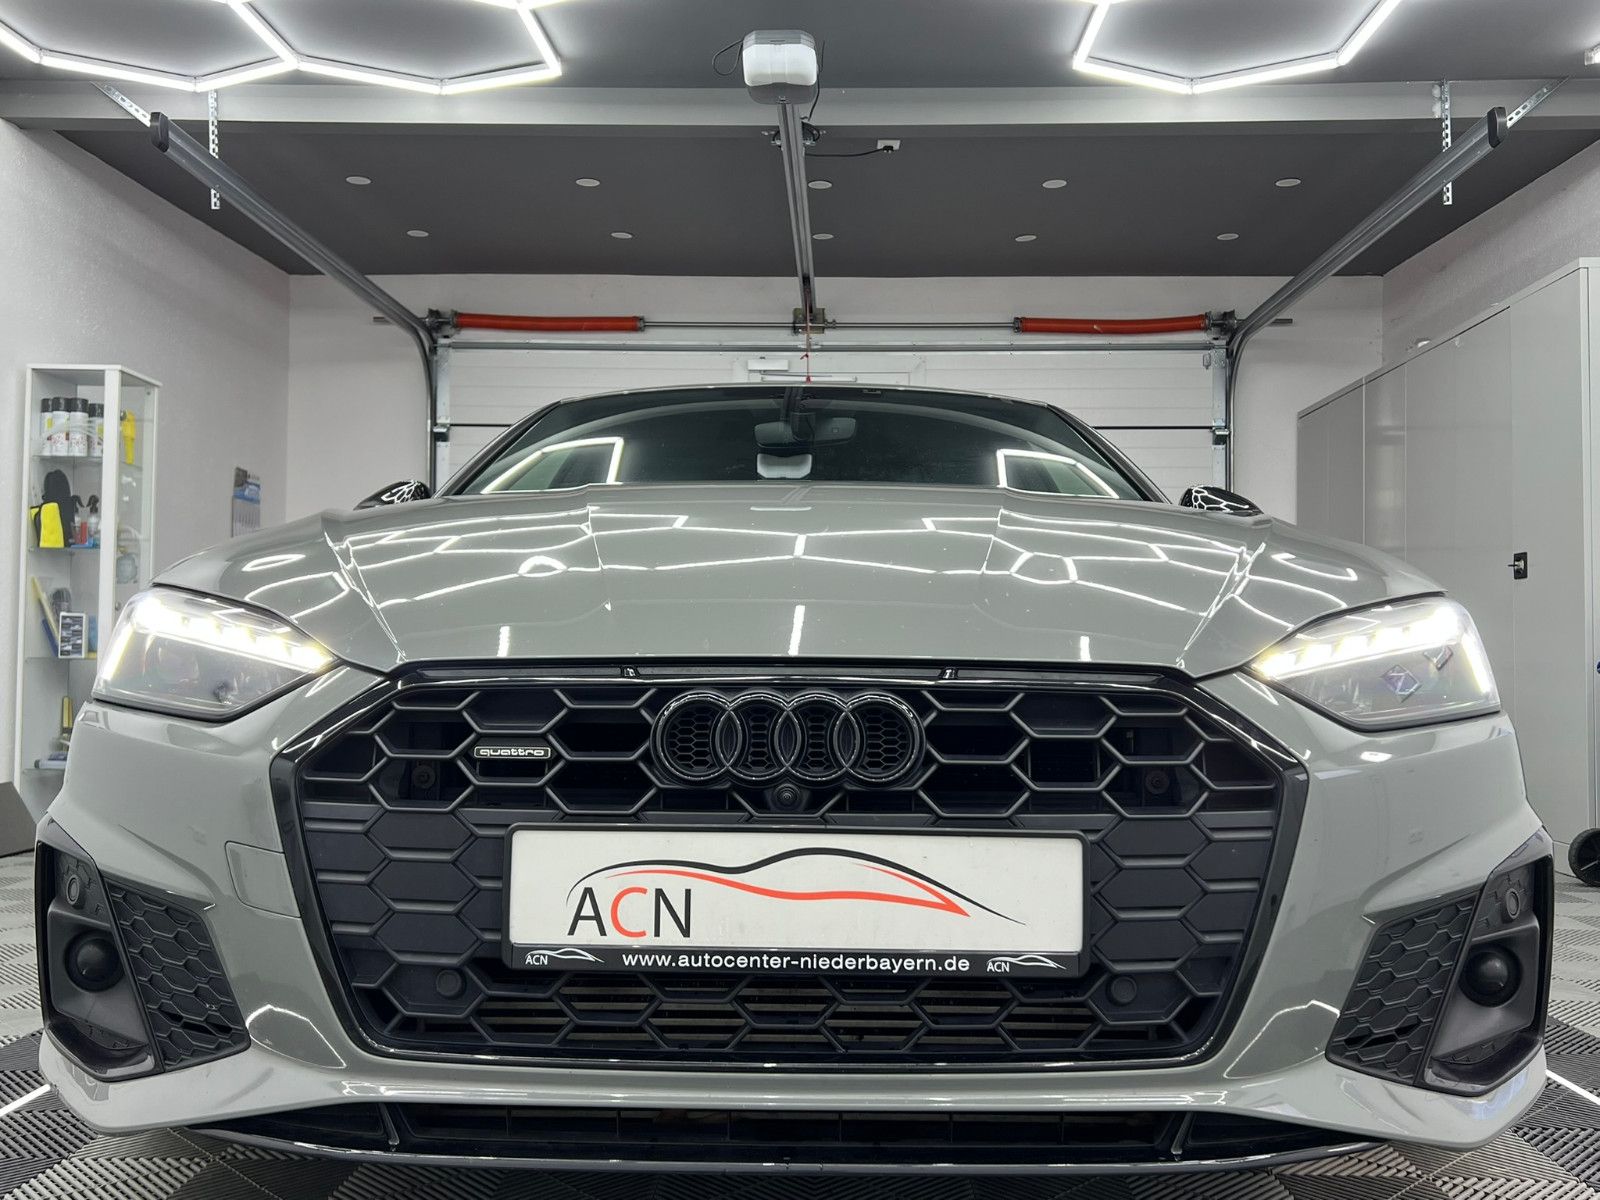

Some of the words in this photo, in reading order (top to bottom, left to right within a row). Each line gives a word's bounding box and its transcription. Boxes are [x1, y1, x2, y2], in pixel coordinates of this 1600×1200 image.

[480, 748, 545, 757] quattro
[567, 886, 692, 938] ACN
[525, 954, 548, 966] ACN
[622, 953, 970, 973] www.autocenter-niederbayern.de
[986, 961, 1010, 973] ACN
